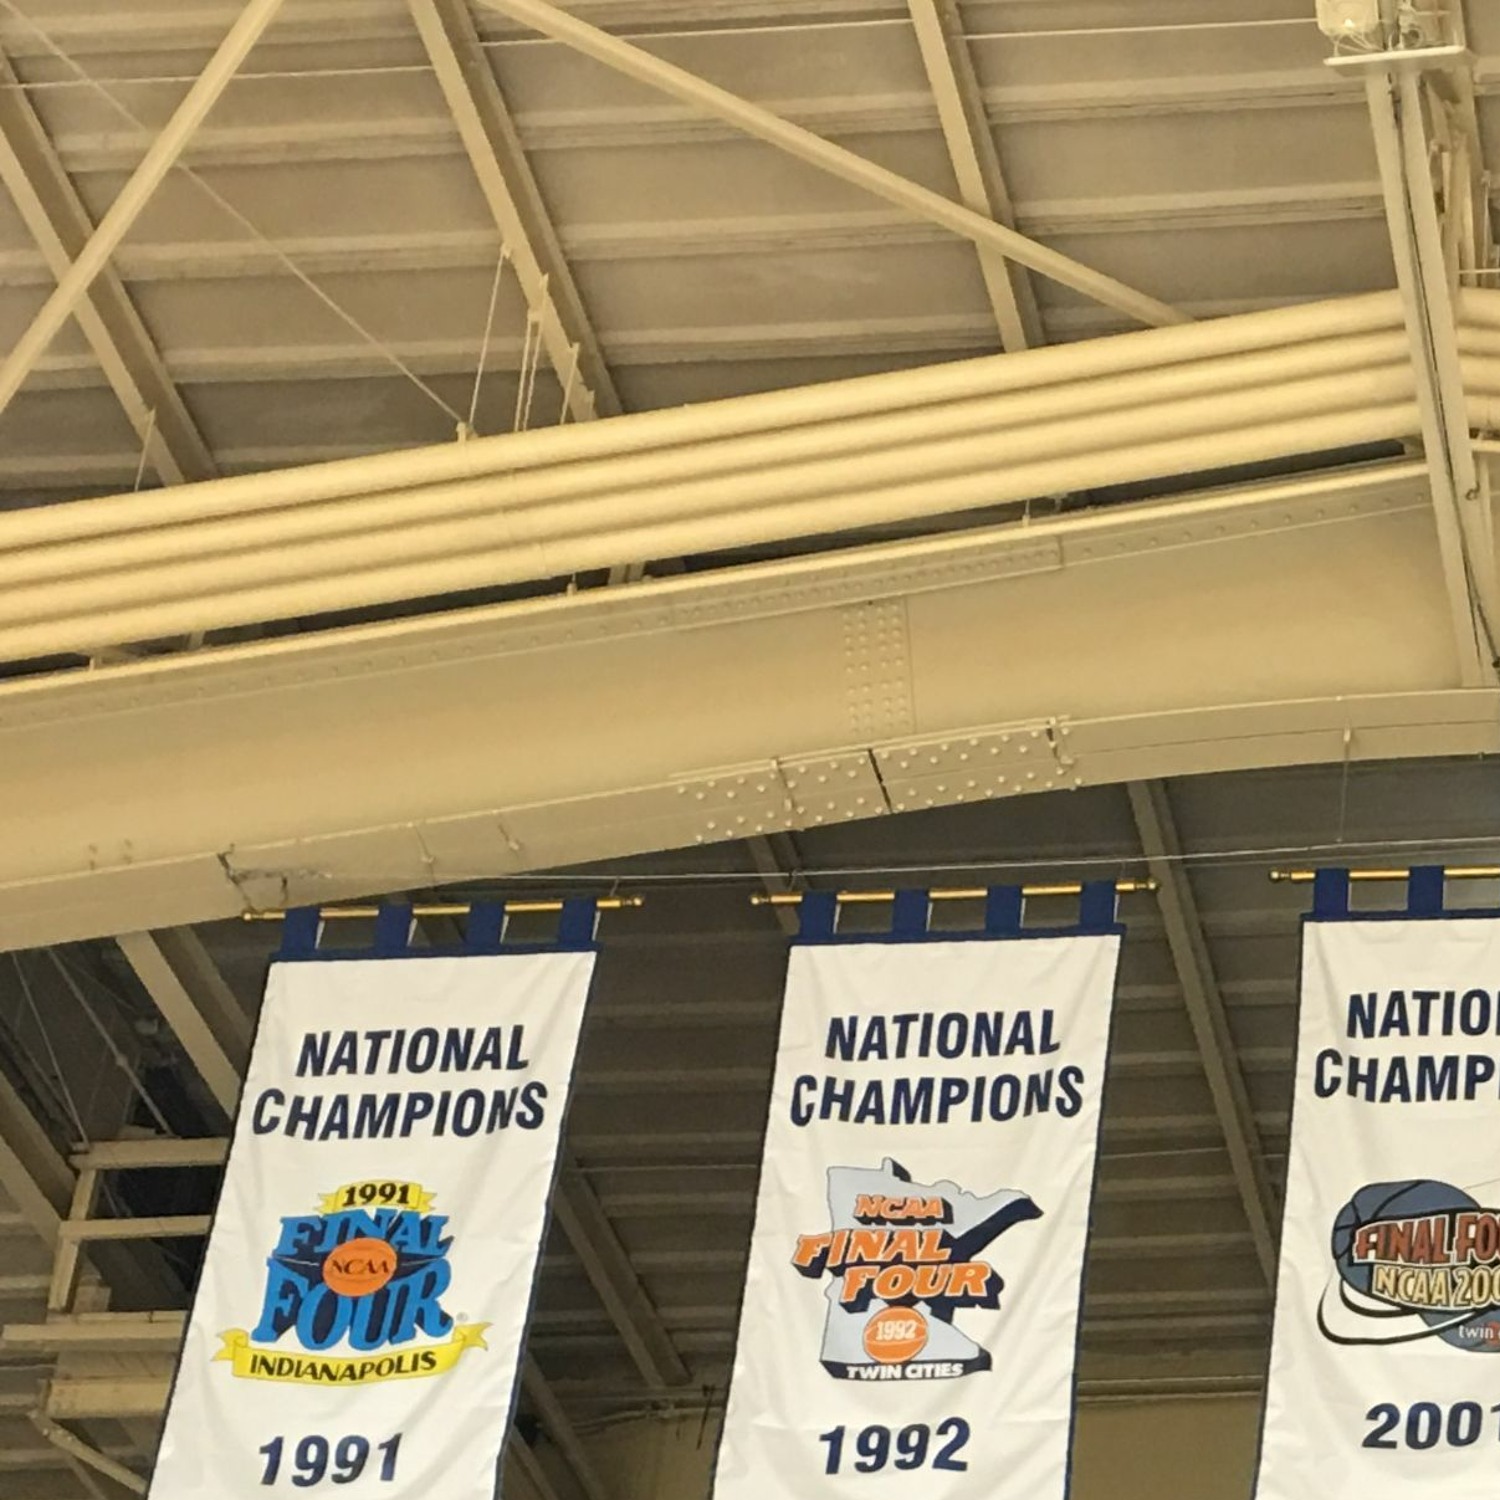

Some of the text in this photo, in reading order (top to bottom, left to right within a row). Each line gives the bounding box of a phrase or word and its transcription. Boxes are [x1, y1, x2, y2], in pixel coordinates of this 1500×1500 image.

[296, 1025, 529, 1077] NATIONAL
[825, 1010, 1060, 1061] NATIONAL
[253, 1081, 548, 1140] CHAMPIONS
[790, 1065, 1084, 1126] CHAMPIONS
[342, 1183, 410, 1207] 1991
[854, 1194, 946, 1221] NCAA
[273, 1208, 453, 1256] FINAL
[791, 1229, 952, 1268] FINAL
[1353, 1214, 1450, 1265] FINAL
[331, 1257, 389, 1275] NCAA
[840, 1261, 992, 1302] FOUR
[1372, 1265, 1450, 1307] NCAA
[252, 1257, 454, 1350] FOUR
[876, 1319, 918, 1341] 1992
[1459, 1325, 1494, 1339] twin
[250, 1351, 436, 1381] INDIANAPOLIS
[847, 1363, 963, 1379] TWIN CITIES
[260, 1433, 402, 1487] 1991
[820, 1417, 970, 1474] 1992
